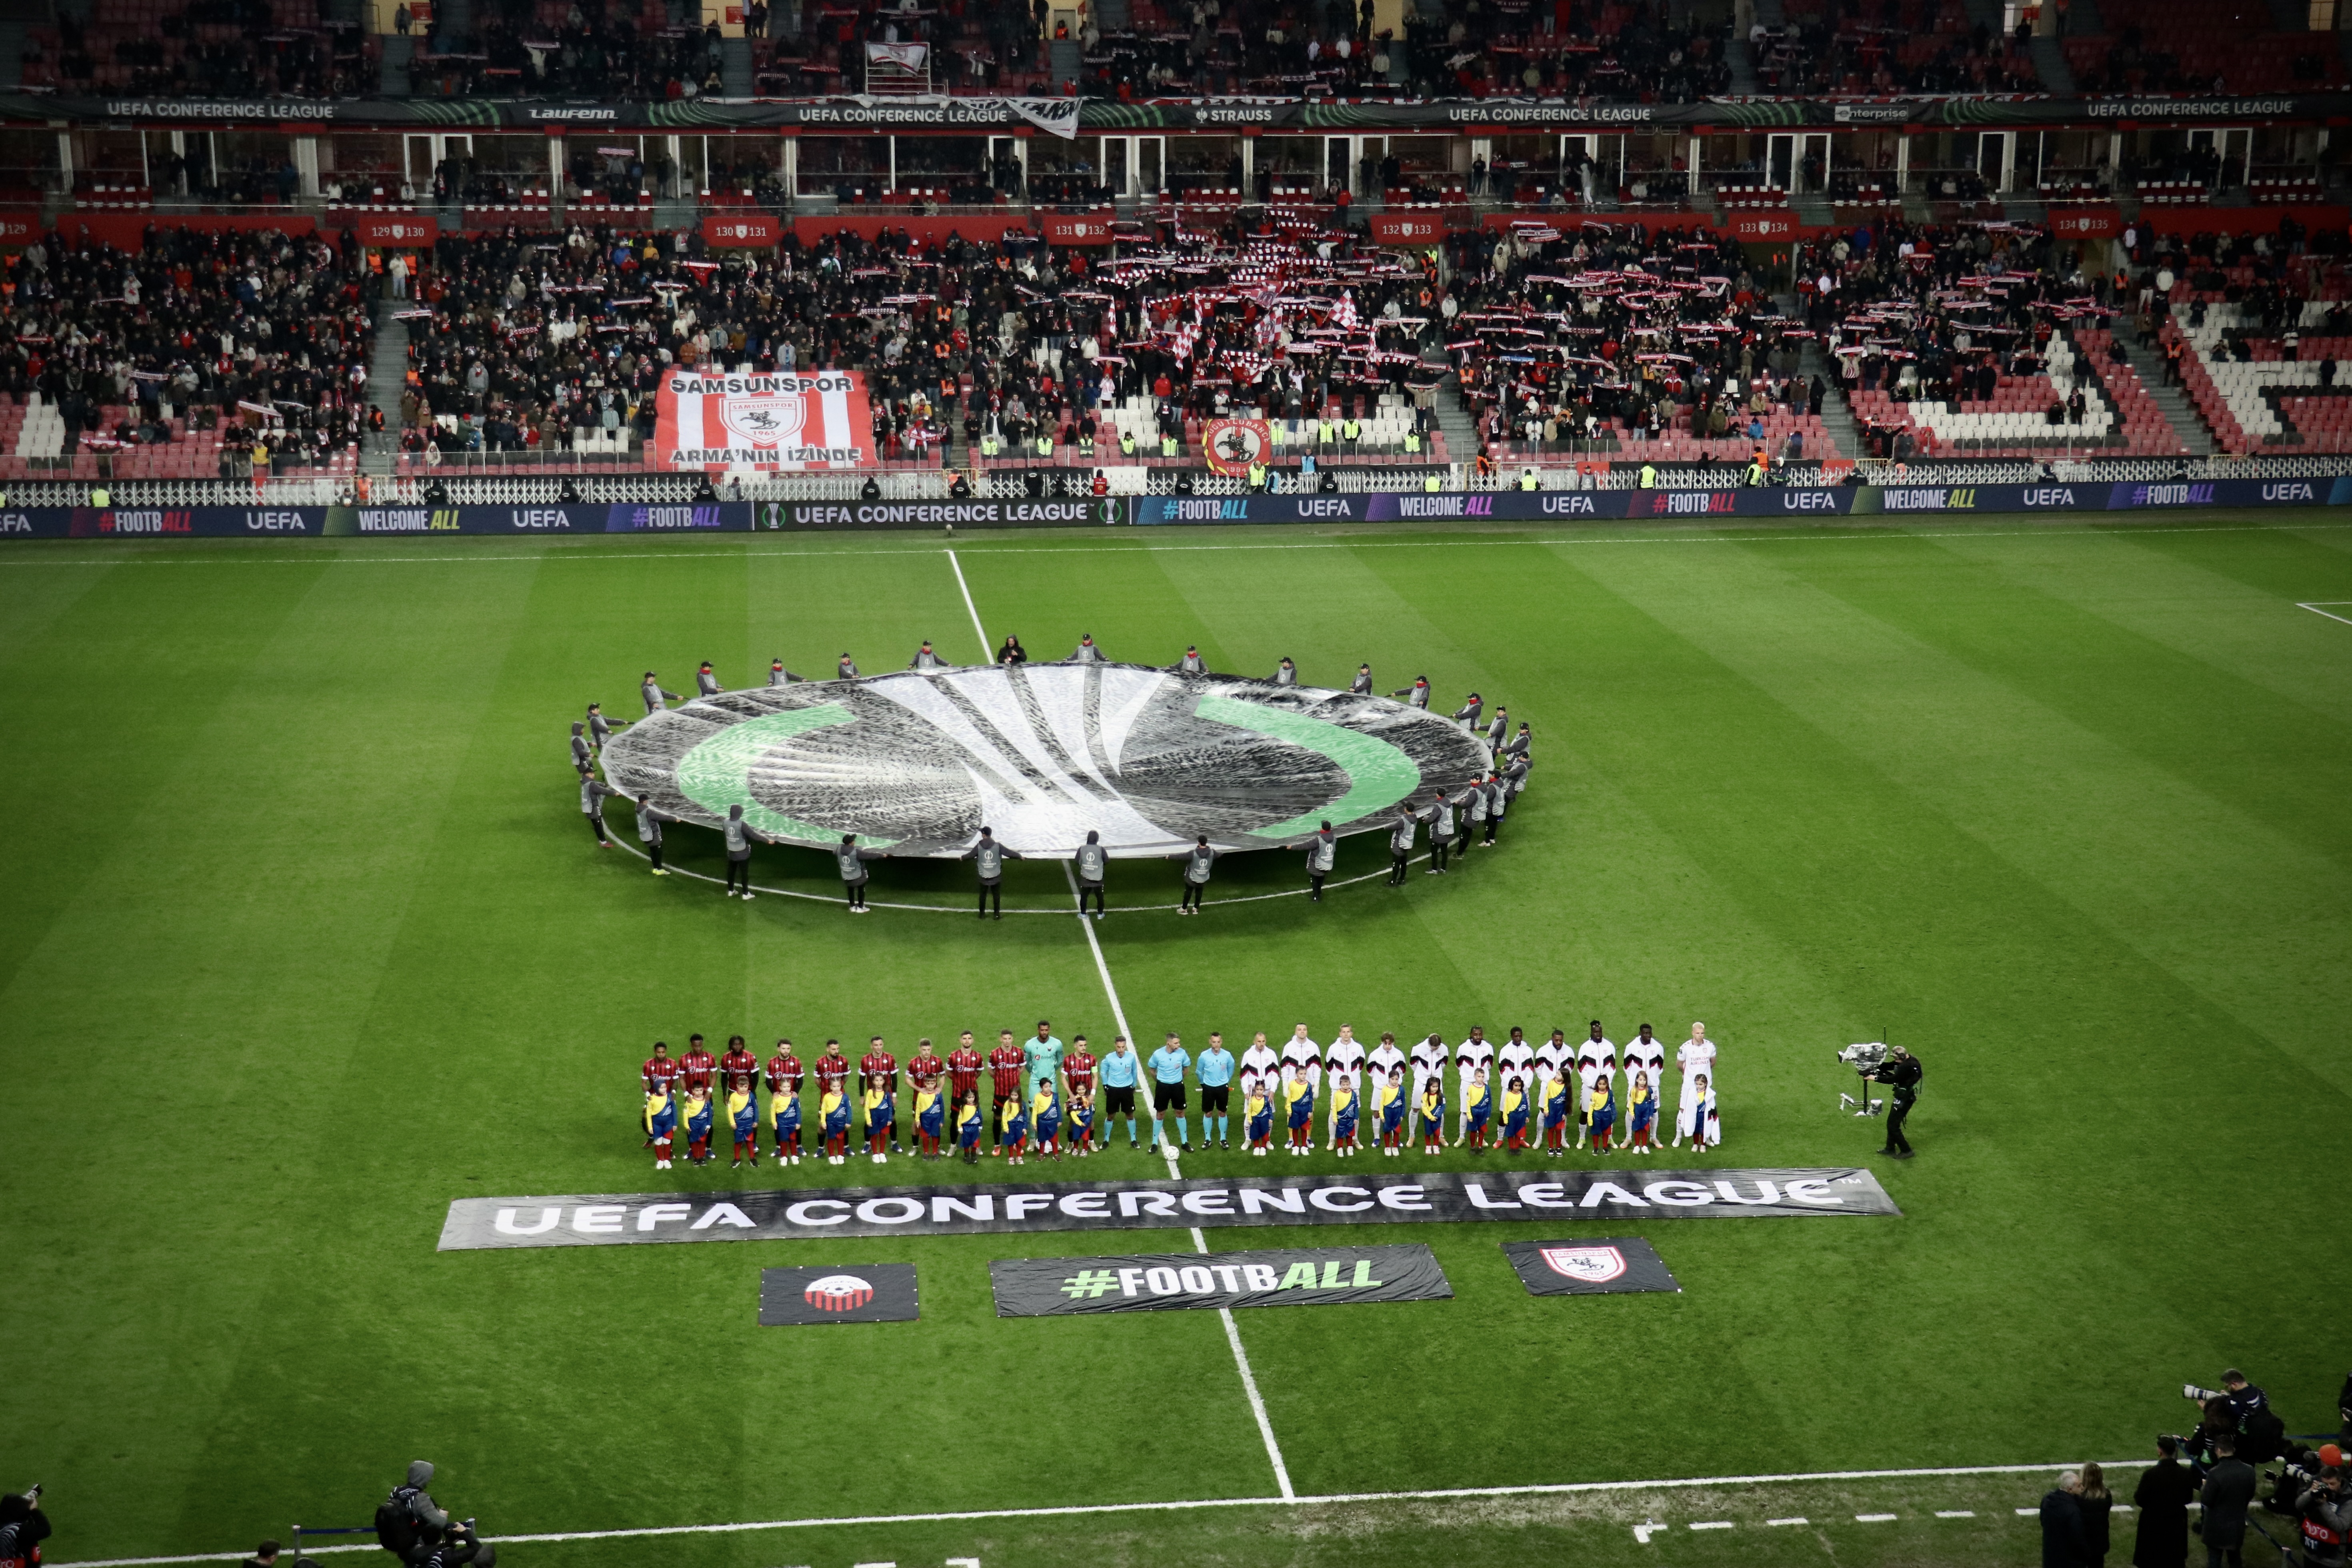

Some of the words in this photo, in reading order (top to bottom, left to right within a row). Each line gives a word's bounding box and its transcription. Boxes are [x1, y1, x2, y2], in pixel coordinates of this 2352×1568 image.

[108, 103, 152, 115] UEFA
[157, 104, 264, 117] CONFERENCE
[271, 104, 333, 118] LEAGUE
[529, 108, 618, 119] Laufenn
[800, 109, 840, 122] UEFA
[844, 109, 944, 122] CONFERENCE
[949, 110, 1007, 122] LEAGUE
[1211, 109, 1272, 122] STRAUSS
[1450, 108, 1489, 121] UEFA
[1492, 108, 1589, 121] CONFERENCE
[1594, 108, 1650, 121] LEAGUE
[1840, 108, 1907, 120] enterprise
[2088, 104, 2126, 117] UEFA
[2131, 102, 2229, 116] CONFERENCE
[2234, 100, 2292, 114] LEAGUE
[7, 224, 26, 234] 129
[372, 227, 390, 237] 129
[406, 228, 424, 237] 130
[716, 227, 733, 237] 130
[749, 227, 767, 237] 131
[1056, 226, 1072, 235] 131
[1088, 226, 1105, 235] 132
[1382, 225, 1399, 234] 132
[1415, 225, 1431, 234] 133
[1740, 223, 1757, 232] 133
[1771, 223, 1788, 232] 134
[2059, 220, 2076, 230] 134
[2091, 220, 2108, 229] 135
[671, 378, 853, 394] SAMSUNSPOR
[1784, 492, 1836, 510] UEFA
[1884, 489, 1946, 509] WELCOME
[1947, 488, 1975, 508] ALL
[2024, 488, 2074, 506] UEFA
[2132, 484, 2214, 505] #FOOTBALL
[2263, 483, 2314, 501] UEFA
[1163, 499, 1248, 520] #FOOTBALL
[1298, 499, 1351, 516] UEFA
[1400, 496, 1463, 517] WELCOME
[1465, 496, 1492, 516] ALL
[1542, 496, 1594, 514] UEFA
[1652, 492, 1735, 513] #FOOTBALL
[98, 511, 192, 532] #FOOTBALL
[247, 512, 306, 530] UEFA
[359, 510, 428, 531] WELCOME
[430, 510, 460, 530] ALL
[513, 510, 570, 528] UEFA
[632, 506, 720, 528] #FOOTBALL
[795, 506, 852, 524] UEFA
[858, 504, 998, 523] CONFERENCE
[1006, 504, 1087, 521] LEAGUE
[494, 1203, 757, 1235] UEFA
[786, 1185, 1432, 1226] CONFERENCE
[1463, 1179, 1845, 1209] LEAGUE
[1061, 1260, 1382, 1298] #FOOTBALL
